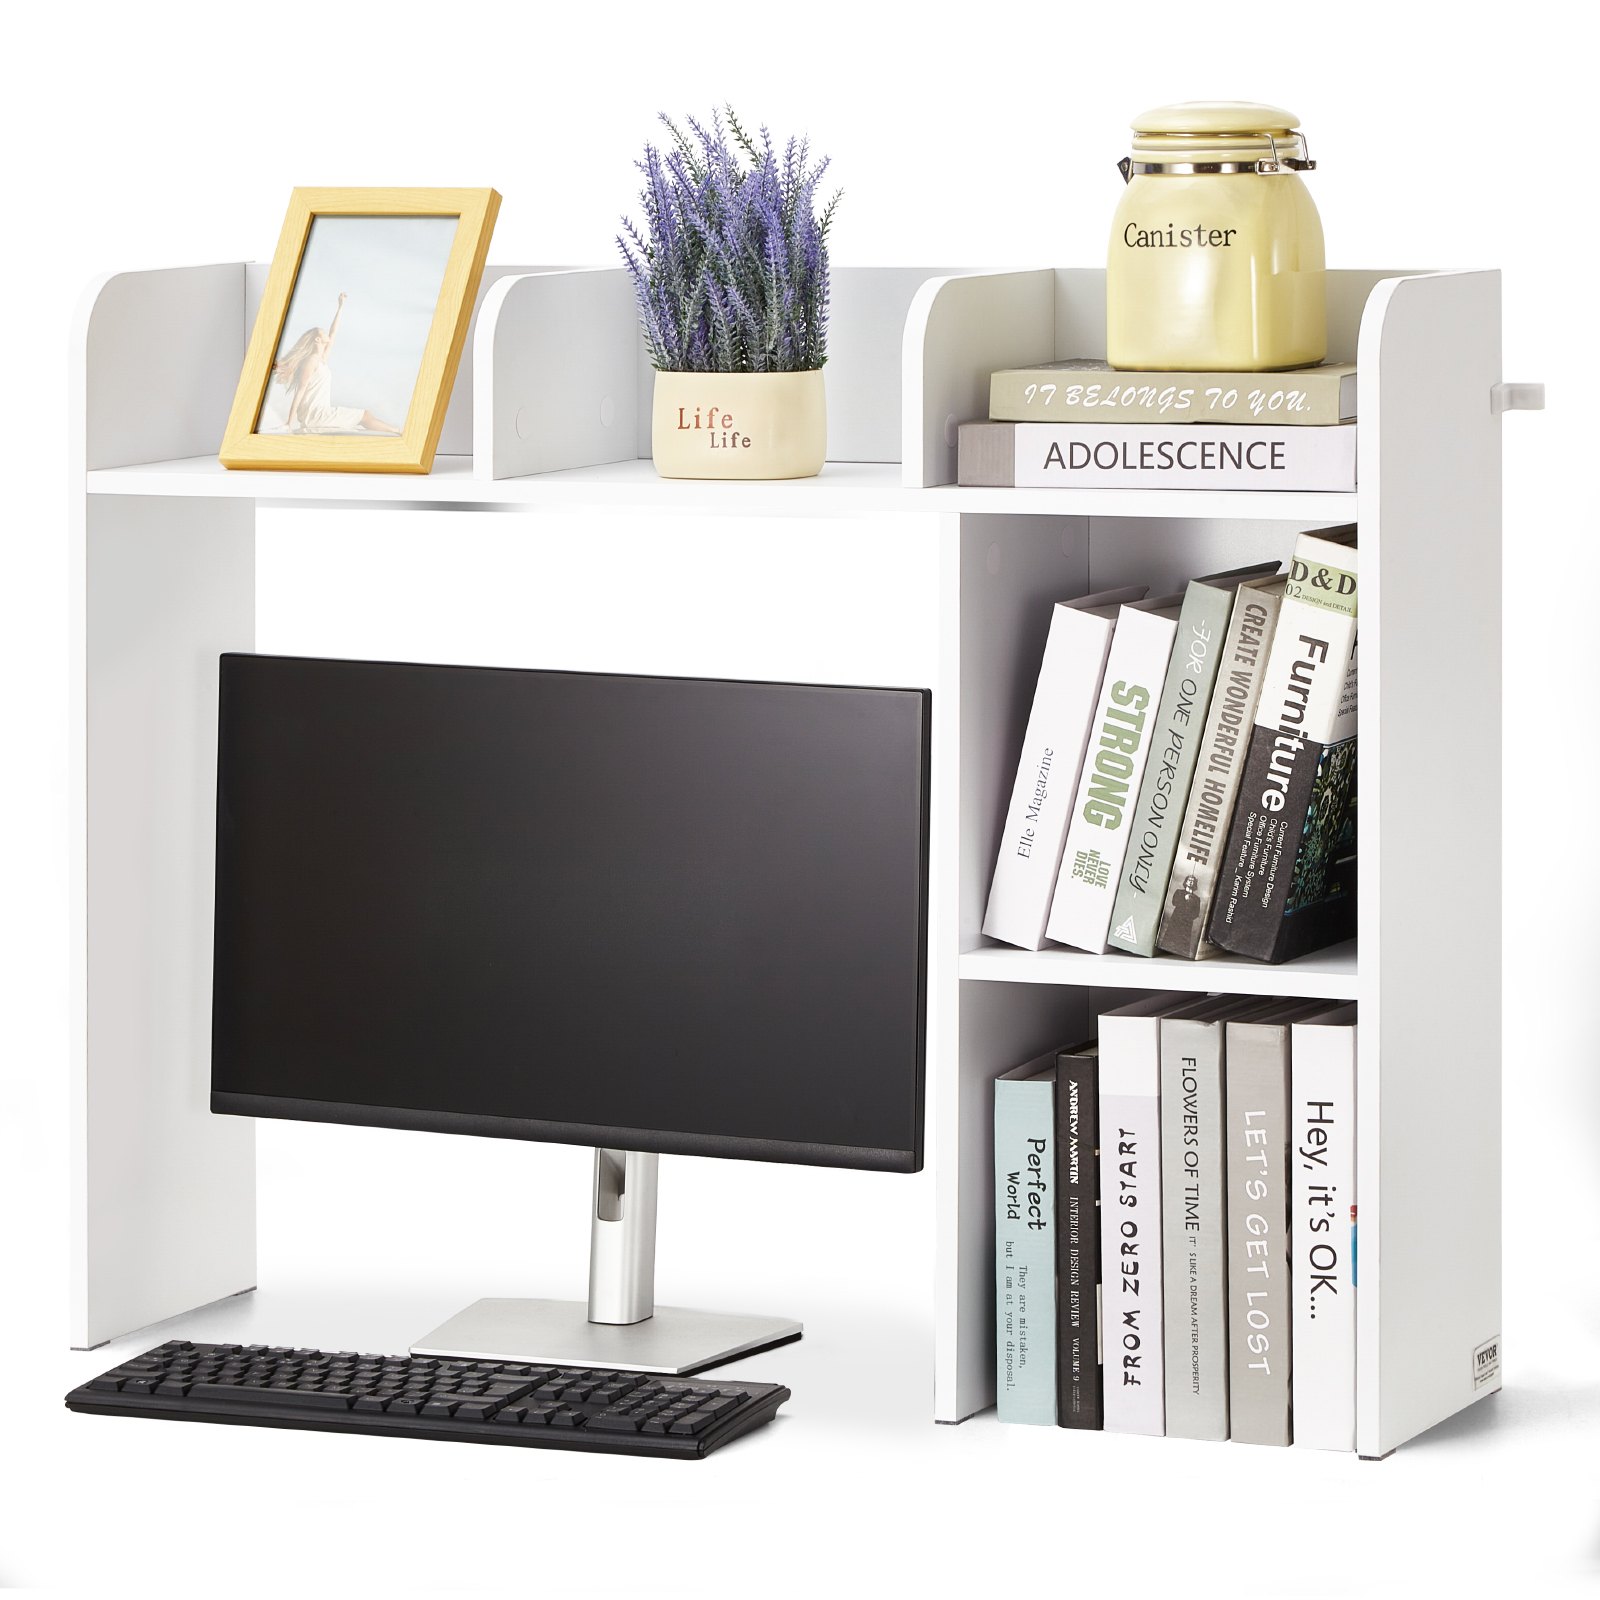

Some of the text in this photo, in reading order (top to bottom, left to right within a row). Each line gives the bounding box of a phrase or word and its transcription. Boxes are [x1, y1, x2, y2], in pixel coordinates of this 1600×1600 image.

[1123, 223, 1237, 249] Canister
[677, 406, 734, 430] Life
[1024, 383, 1312, 417] IT BELONGS TO YOU.
[710, 431, 751, 448] Life
[1043, 441, 1286, 470] ADOLESCENCE
[1285, 583, 1302, 599] 02
[1302, 594, 1323, 605] DESIGN
[1323, 600, 1332, 608] and
[1173, 678, 1197, 727] ONE
[1186, 603, 1268, 866] CREATE WONDERFUL HOMELIFE
[1261, 634, 1330, 812] Furniture
[1083, 679, 1150, 831] STRONG
[1148, 728, 1185, 828] PERSON
[1016, 746, 1055, 861] Elle Magazine
[1244, 812, 1256, 839] Special
[1071, 850, 1088, 878] DIES.
[1082, 849, 1101, 885] NEVER
[1238, 840, 1250, 868] Feature
[1242, 815, 1268, 898] Office Furniture System
[1258, 844, 1272, 876] Furniture
[1262, 821, 1288, 908] Current Furniture Design
[1094, 860, 1112, 890] LOVE
[1226, 897, 1238, 924] Rashid
[1069, 1080, 1079, 1136] ANDREW
[1069, 1136, 1079, 1184] MARTIN
[1181, 1056, 1200, 1232] FLOWERS OF TIME
[1006, 1171, 1021, 1220] World
[1026, 1138, 1047, 1230] Perfect
[1070, 1196, 1079, 1244] INTERIOR
[1299, 1101, 1338, 1320] Hey, it's OK...
[1005, 1241, 1015, 1259] but
[1118, 1128, 1142, 1386] FROM ZERO START
[1244, 1110, 1271, 1376] LET'S GET LOST
[1006, 1276, 1013, 1289] am
[1070, 1249, 1080, 1286] DESIGN
[1006, 1294, 1014, 1306] at
[1018, 1265, 1029, 1369] They are mistaken,
[1070, 1290, 1080, 1328] REVIEW
[1190, 1284, 1198, 1316] DREAM
[1004, 1312, 1013, 1336] your
[1190, 1317, 1199, 1344] AFTER
[1004, 1341, 1016, 1392] disposal.
[1072, 1338, 1080, 1373] VOLUME
[1191, 1345, 1200, 1395] PROSPERITY
